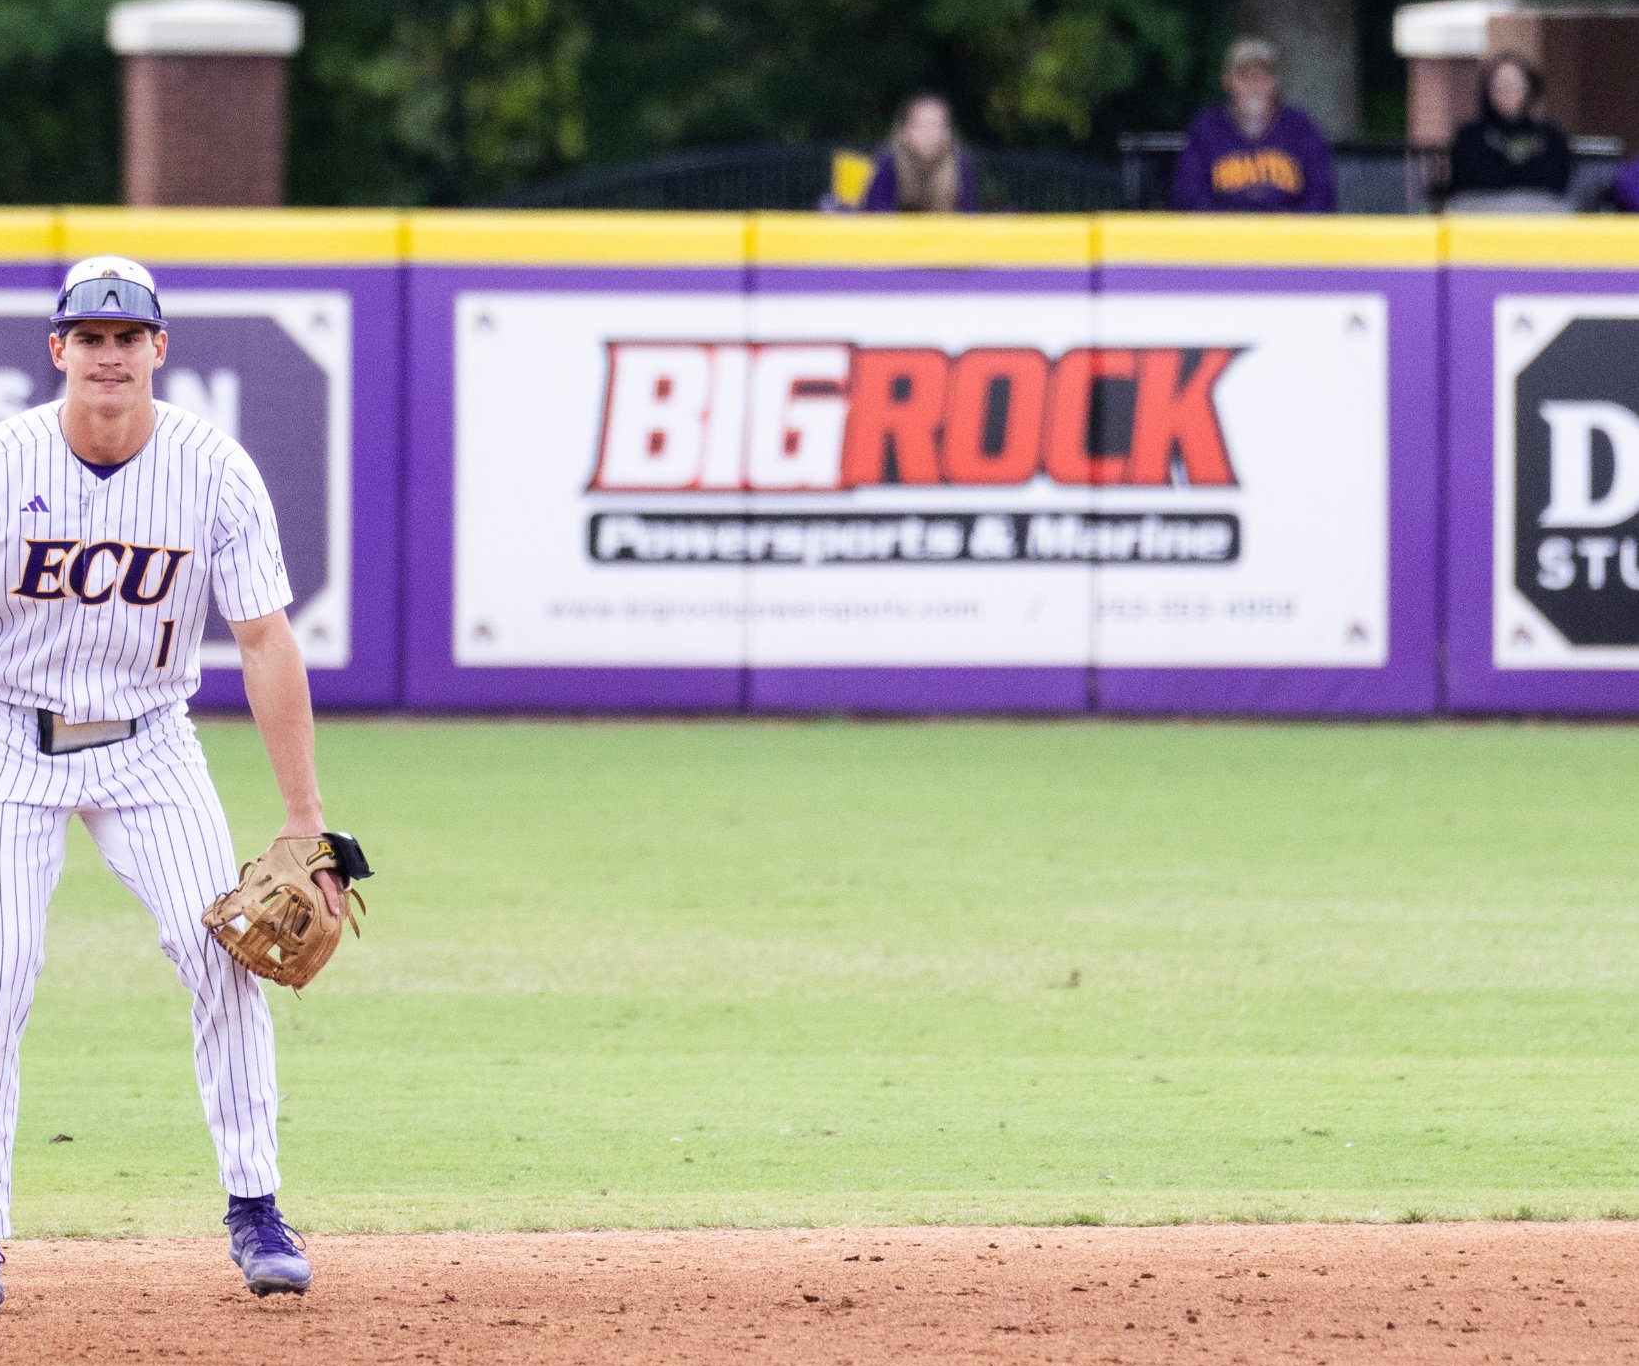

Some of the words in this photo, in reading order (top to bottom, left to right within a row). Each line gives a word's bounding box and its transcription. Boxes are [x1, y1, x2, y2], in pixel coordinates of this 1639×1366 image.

[597, 514, 963, 564] Powersports
[967, 515, 1019, 560] &
[1024, 514, 1234, 560] Marine
[10, 537, 194, 607] ECU
[155, 619, 175, 669] 1
